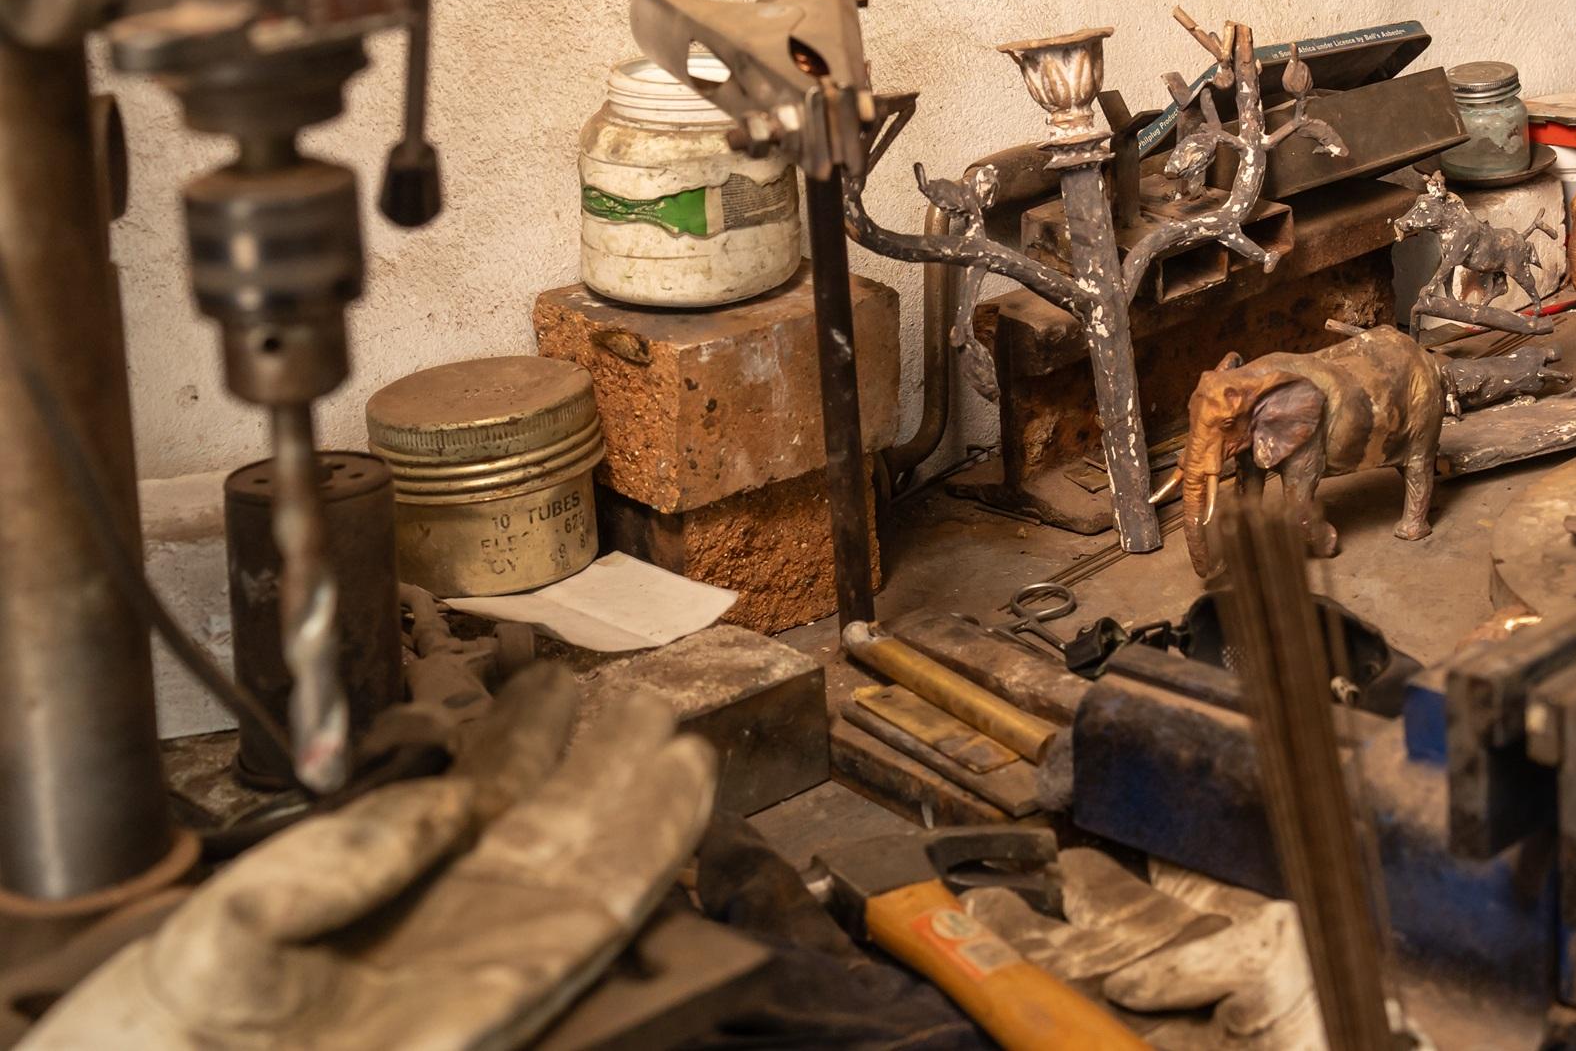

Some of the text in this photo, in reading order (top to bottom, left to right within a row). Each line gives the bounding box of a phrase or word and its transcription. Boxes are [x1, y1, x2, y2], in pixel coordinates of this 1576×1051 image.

[1333, 37, 1356, 48] Licence
[1356, 36, 1365, 46] by
[528, 490, 580, 525] TUBES
